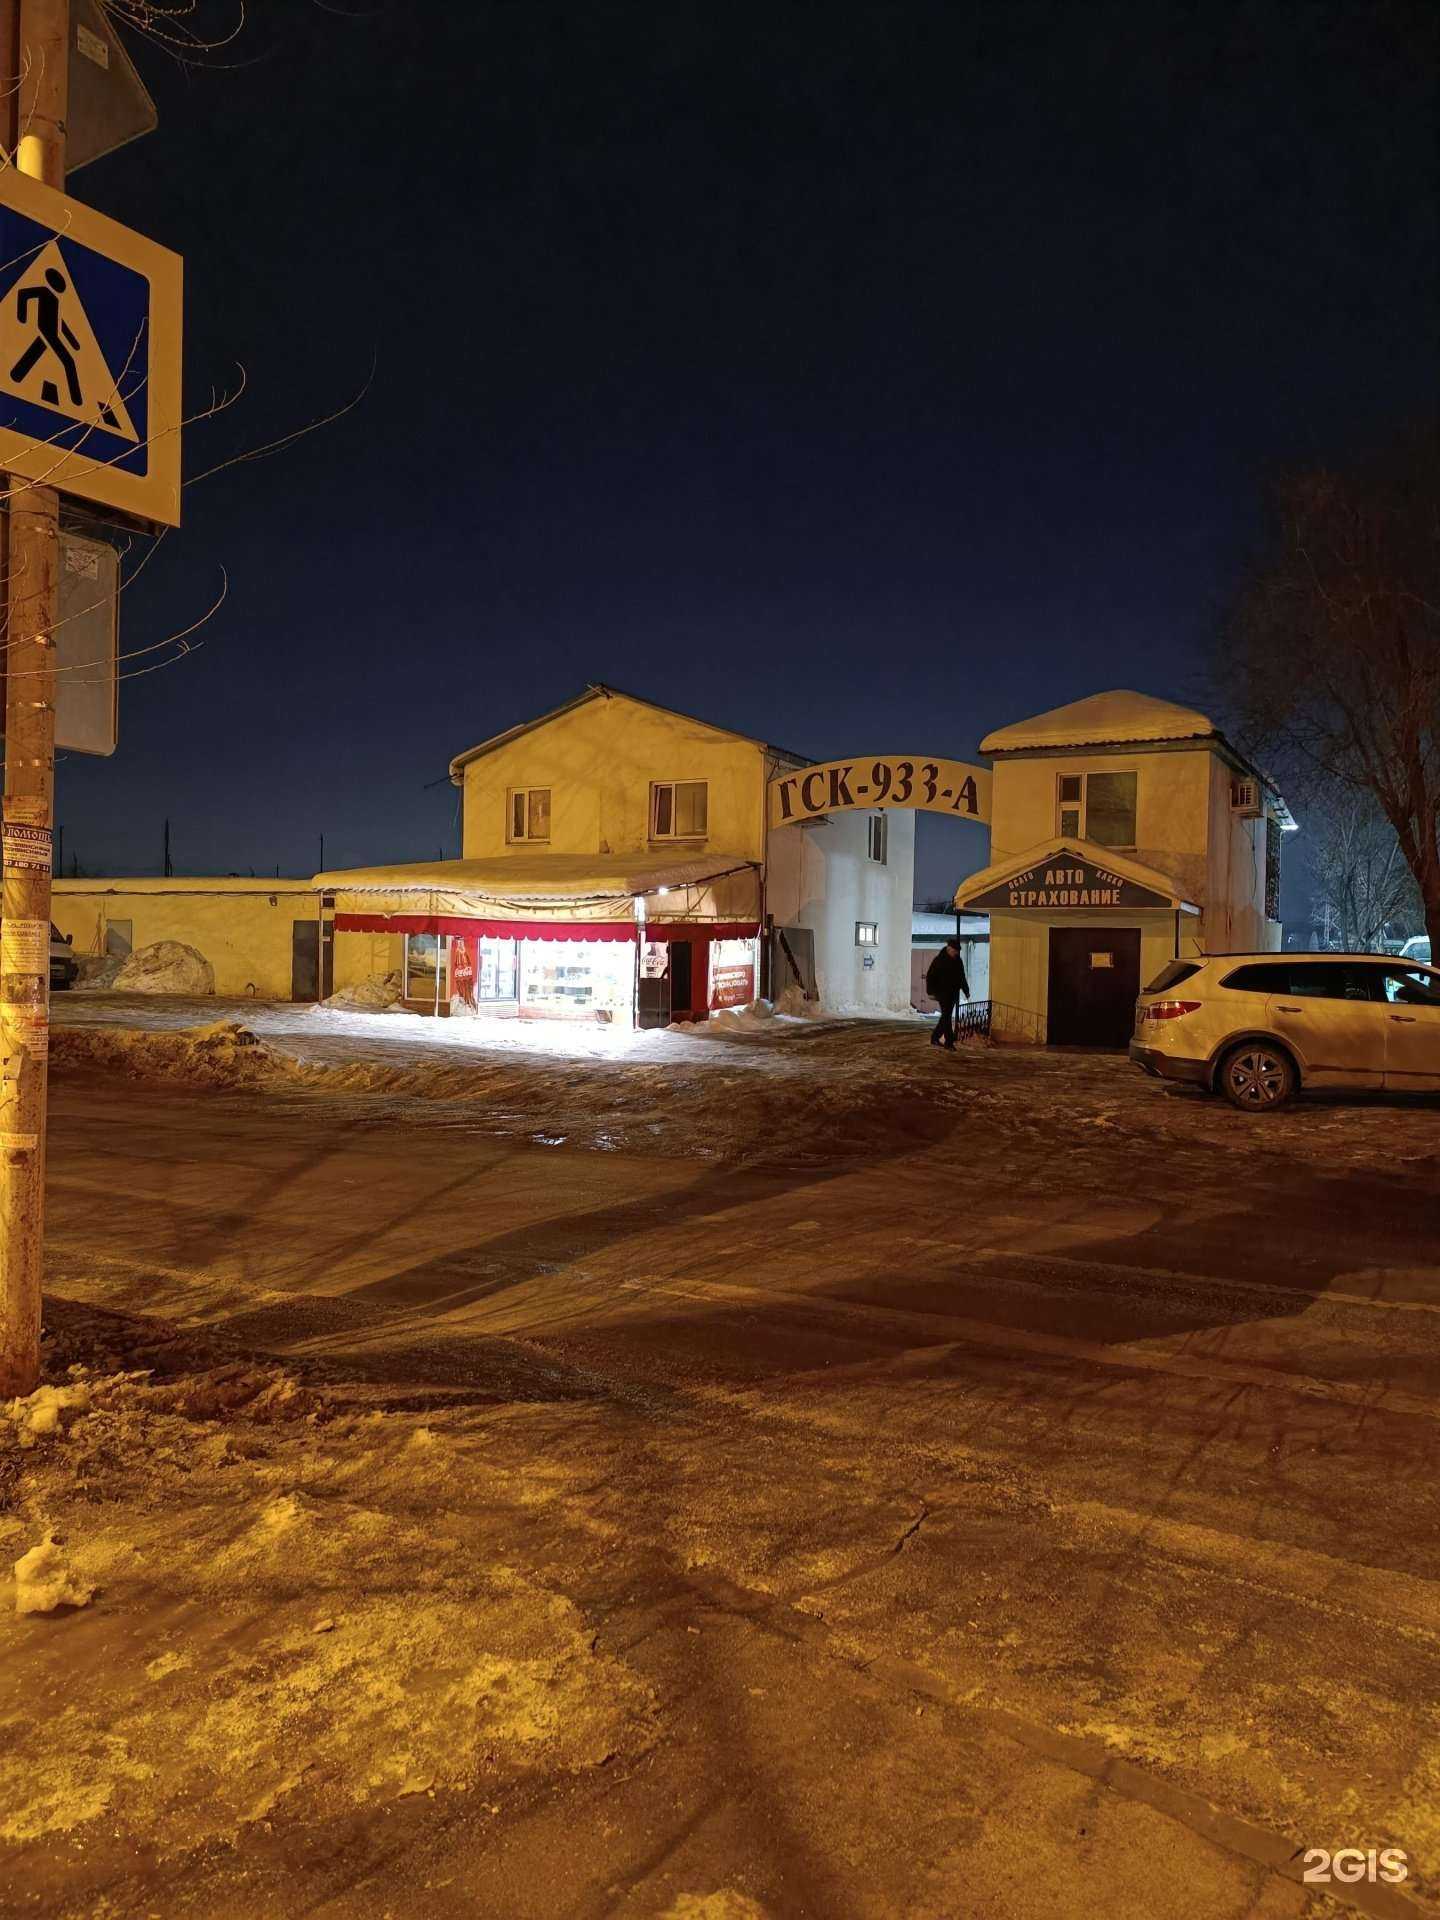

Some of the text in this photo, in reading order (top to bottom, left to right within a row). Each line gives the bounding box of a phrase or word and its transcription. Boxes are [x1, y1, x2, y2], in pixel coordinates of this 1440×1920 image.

[778, 762, 979, 819] ГСК-933-А
[1008, 871, 1034, 889] ОСАГО
[1045, 869, 1084, 885] АВТО
[1096, 870, 1124, 888] КАСКО
[1009, 889, 1121, 906] СТРАХОВАНИЕ
